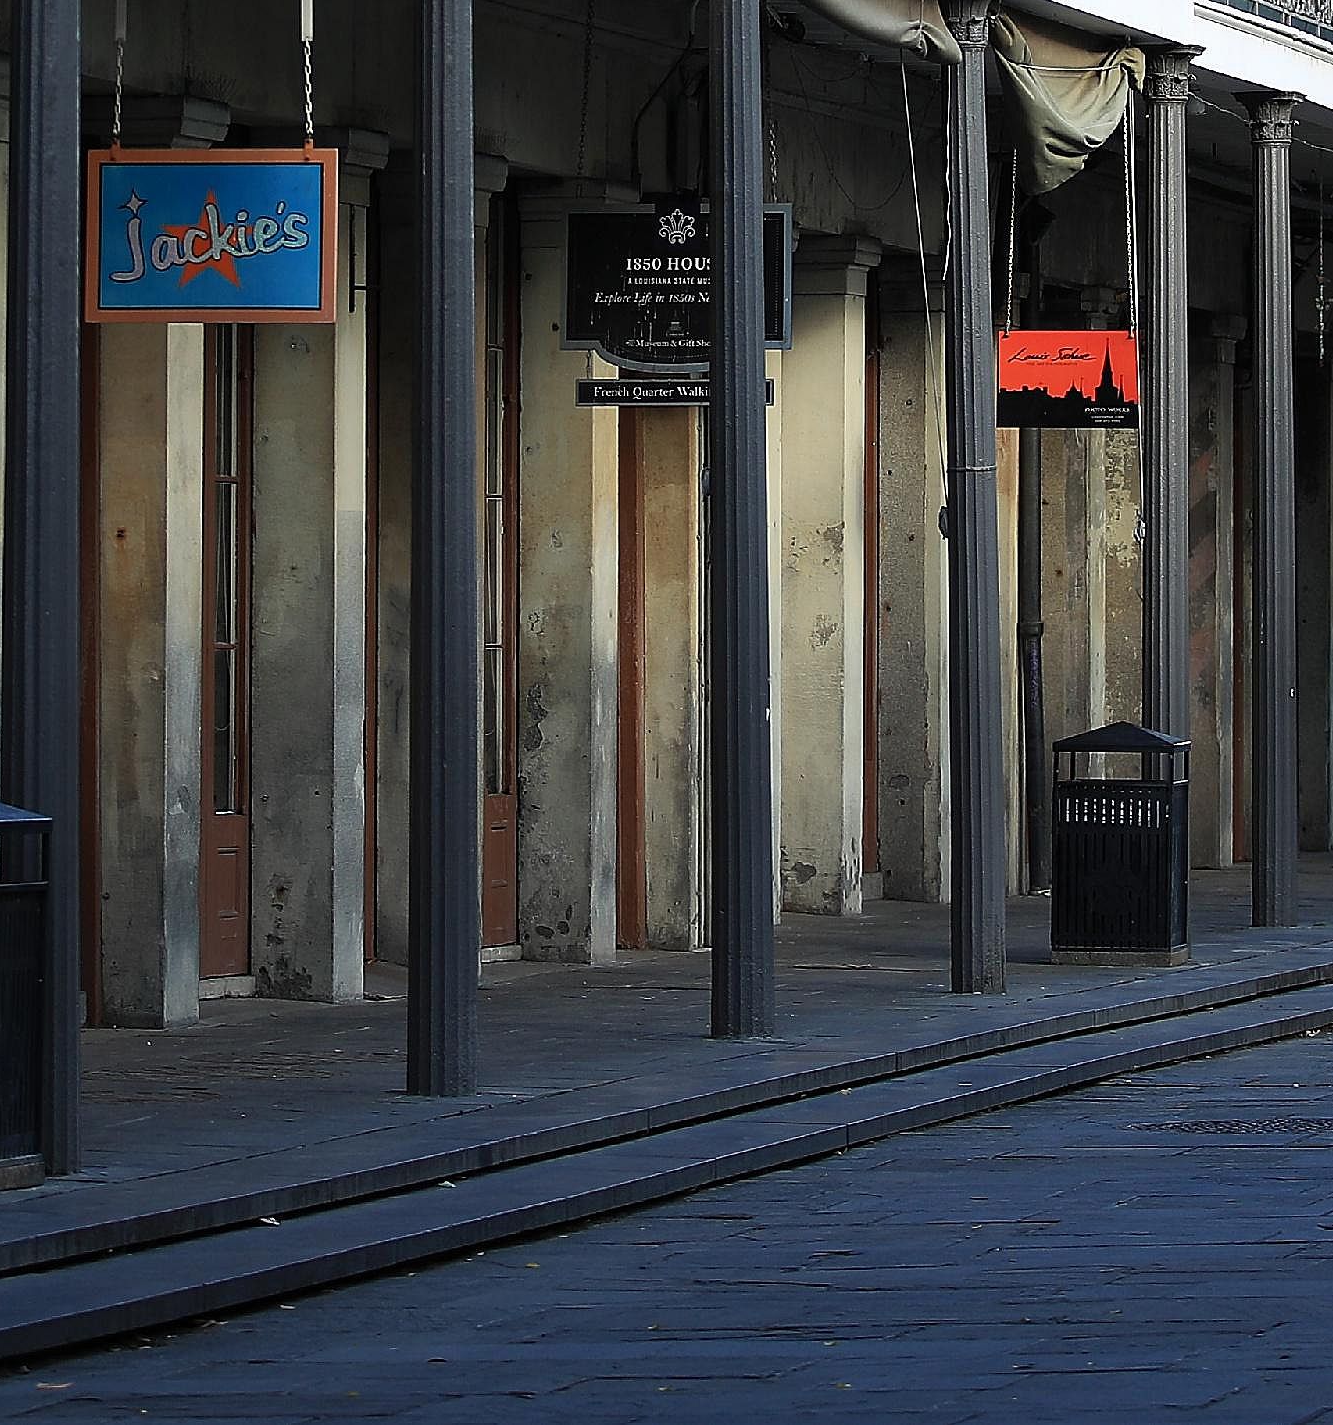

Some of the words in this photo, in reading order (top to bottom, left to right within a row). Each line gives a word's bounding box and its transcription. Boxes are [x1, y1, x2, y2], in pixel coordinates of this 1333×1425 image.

[626, 257, 662, 272] 1850
[666, 257, 712, 272] HOU
[627, 277, 633, 285] A
[634, 277, 672, 285] LOUISIANA
[673, 276, 696, 285] STATE
[594, 292, 632, 307] Explore
[633, 292, 653, 306] Life
[655, 292, 666, 303] in
[668, 293, 696, 303] 1850s
[635, 339, 669, 347] Museum
[670, 339, 677, 347] &
[678, 339, 695, 347] Gift
[594, 386, 630, 397] French
[632, 386, 674, 400] Quarter
[676, 386, 709, 397] Walki
